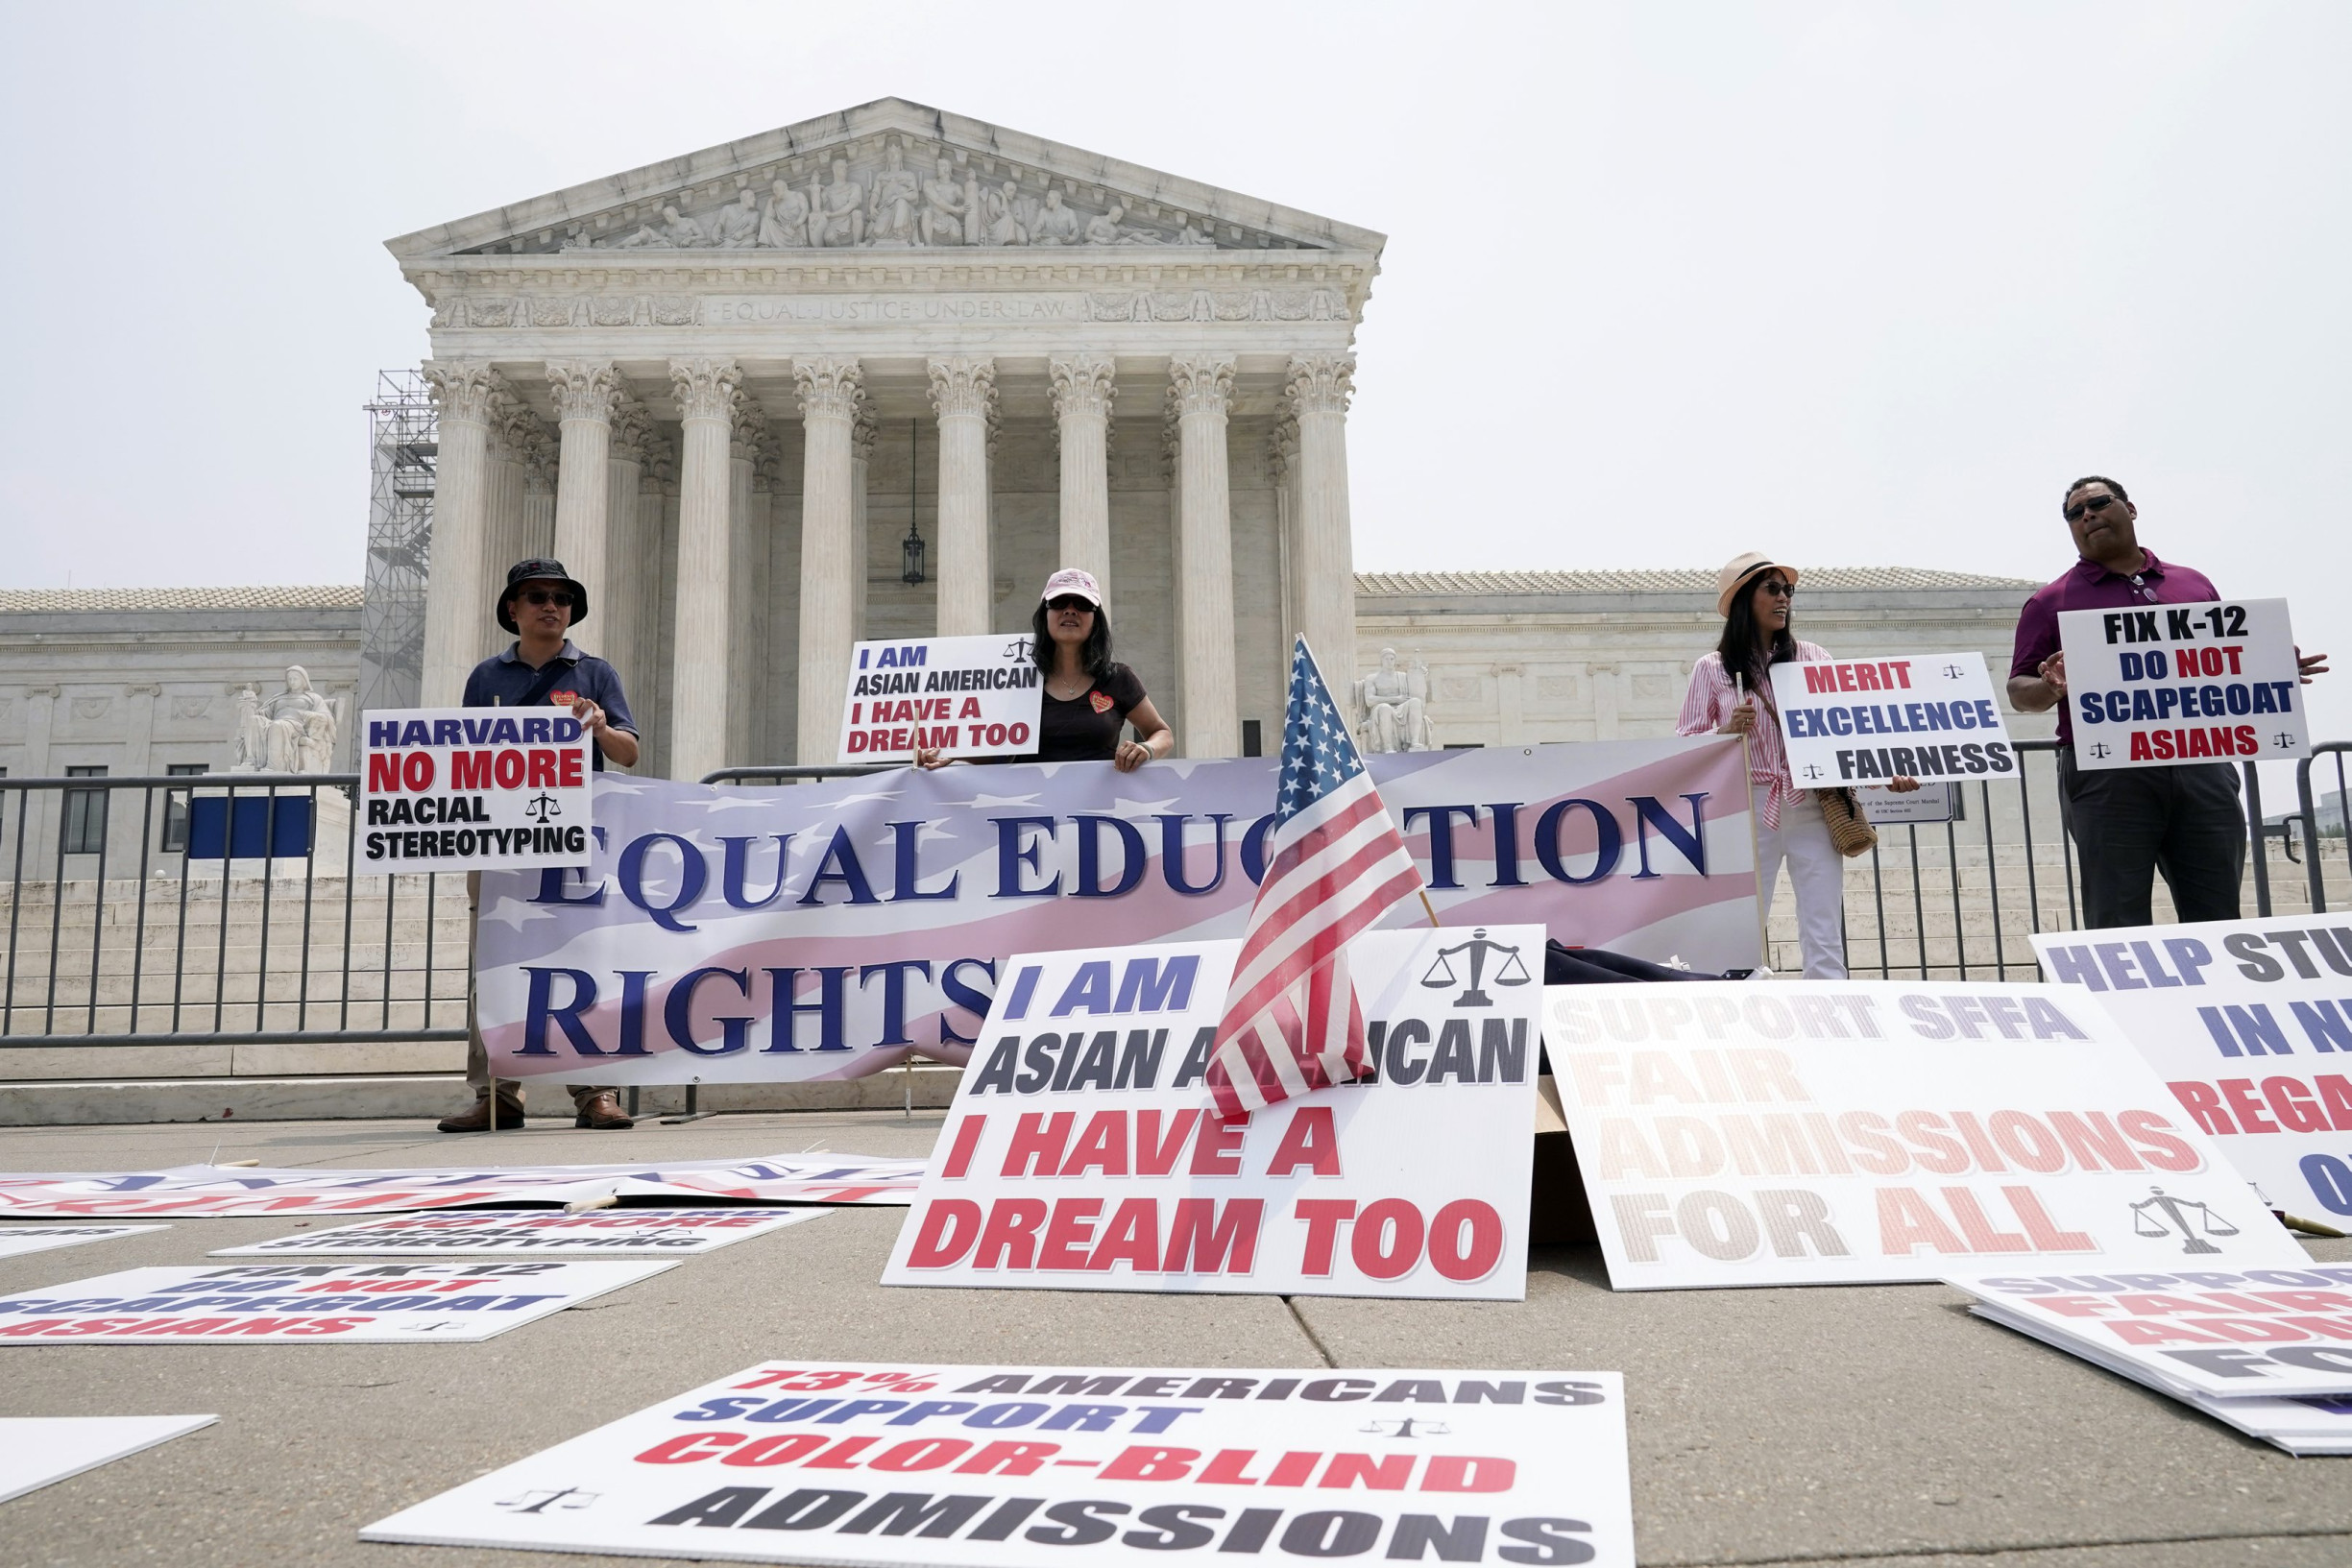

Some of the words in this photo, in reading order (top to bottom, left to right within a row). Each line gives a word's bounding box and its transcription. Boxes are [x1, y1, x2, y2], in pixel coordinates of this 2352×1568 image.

[721, 302, 804, 322] EQUAL
[810, 301, 910, 320] JUSTICE
[924, 300, 1004, 319] UNDER
[1018, 299, 1066, 318] LAW
[2103, 611, 2162, 644] FIX
[2166, 605, 2248, 640] K-12
[859, 648, 870, 669] I
[876, 645, 928, 668] AM
[2119, 650, 2169, 682] DO
[2175, 645, 2243, 678] NOT
[854, 672, 920, 696] ASIAN
[924, 666, 1038, 692] AMERICAN
[1803, 661, 1911, 694] MERIT
[851, 702, 862, 725] I
[871, 697, 952, 723] HAVE
[958, 696, 982, 719] A
[1785, 699, 1999, 738] EXCELLENCE
[2079, 681, 2293, 724] SCAPEGOAT
[369, 717, 583, 748] HARVARD
[847, 725, 959, 754] DREAM
[968, 721, 1031, 747] TOO
[2130, 725, 2259, 761] ASIANS
[368, 751, 434, 792] NO
[450, 748, 583, 790] MORE
[1835, 741, 2013, 780] FAIRNESS
[368, 796, 490, 825] RACIAL
[366, 826, 585, 859] STEREOTYPING
[987, 792, 1710, 900] EDUTION
[2046, 937, 2213, 992] HELP
[1003, 965, 1044, 1020] I
[1049, 954, 1201, 1018] AM
[512, 956, 997, 1056] RIGHTS
[1553, 994, 1879, 1044] SUPPORT
[1897, 994, 2089, 1041] SFFA
[2195, 1003, 2294, 1057] IN
[968, 1028, 1172, 1096] ASIAN
[1174, 1017, 1528, 1090] AICAN
[1573, 1048, 1811, 1105] FAIR
[941, 1115, 989, 1179] I
[1000, 1107, 1252, 1177] HAVE
[1266, 1106, 1342, 1177] A
[1598, 1109, 2201, 1182] ADMISSIONS
[307, 1227, 542, 1238] RACIAL
[354, 1218, 497, 1230] NO
[502, 1217, 777, 1228] MORE
[907, 1197, 1265, 1275] DREAM
[1294, 1197, 1504, 1281] TOO
[1609, 1188, 1852, 1263] FOR
[1874, 1185, 2096, 1257] ALL
[257, 1238, 708, 1249] STEREOTYPING
[148, 1280, 300, 1293] DO
[295, 1279, 502, 1292] NOT
[193, 1265, 341, 1278] FIX
[347, 1263, 569, 1277] K-12
[0, 1295, 568, 1314] SCAPEGOAT
[2024, 1291, 2352, 1317] FAIR
[0, 1316, 377, 1337] ASIANS
[727, 1370, 943, 1394] 73%
[950, 1374, 1606, 1407] AMERICANS
[673, 1397, 1204, 1435] SUPPORT
[633, 1432, 1517, 1493] COLOR-BLIND
[643, 1485, 1596, 1566] ADMISSIONS
